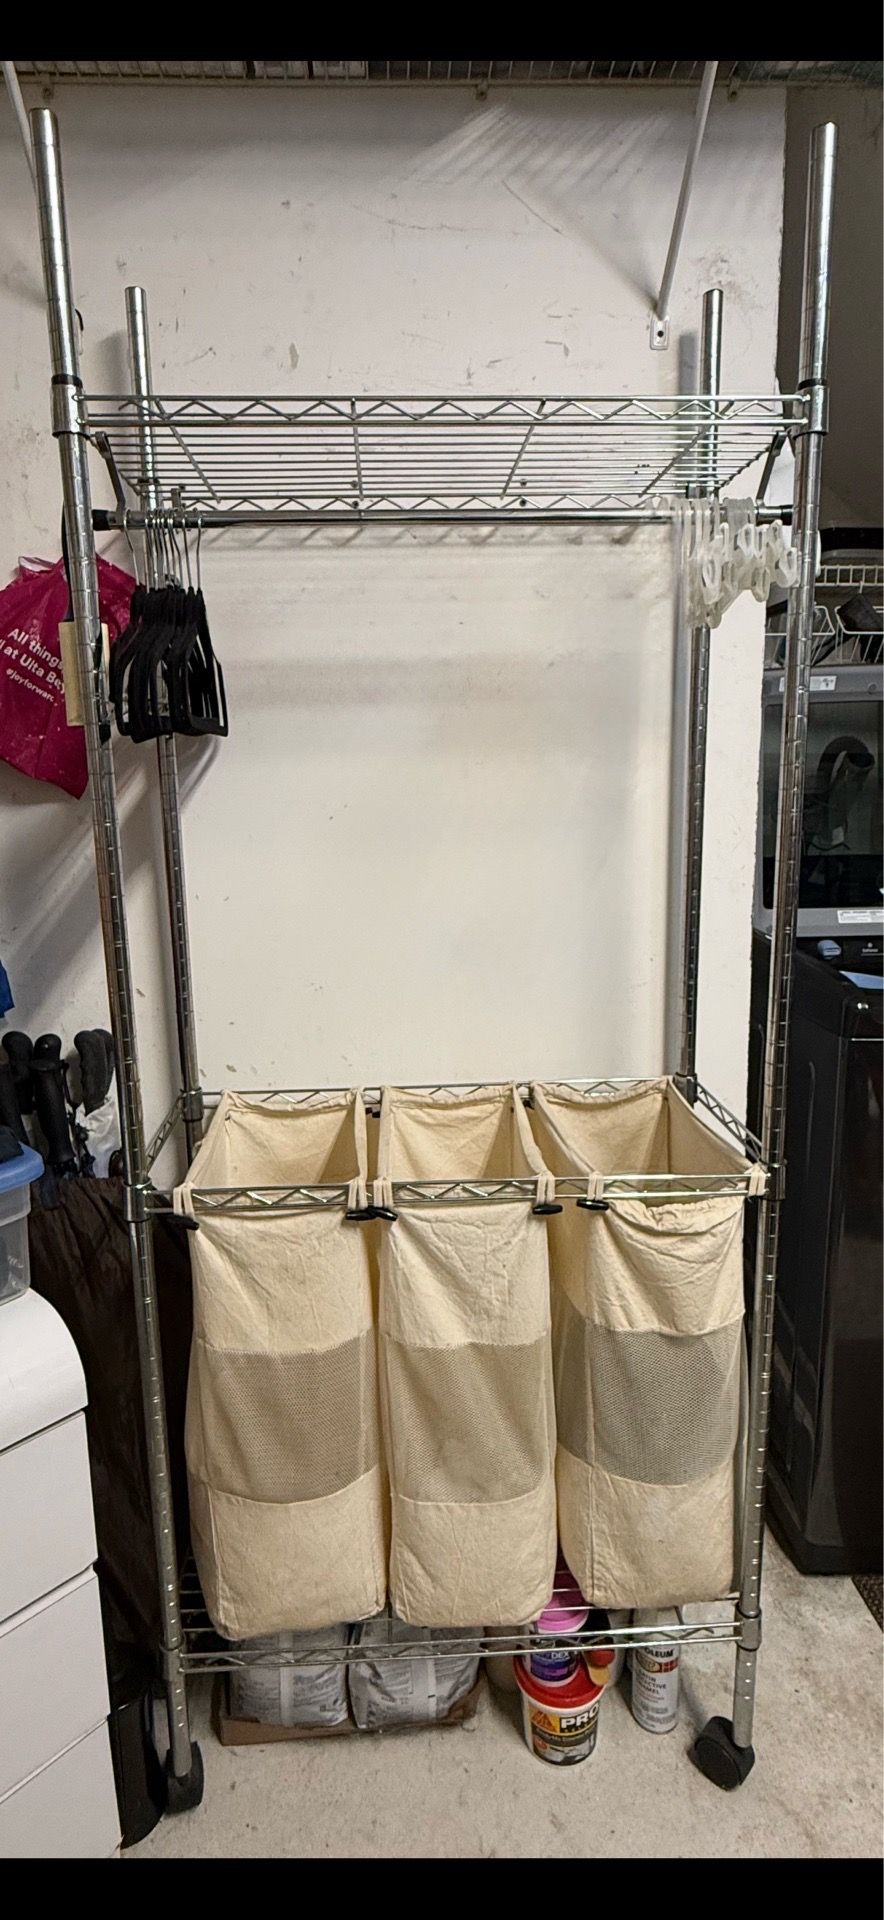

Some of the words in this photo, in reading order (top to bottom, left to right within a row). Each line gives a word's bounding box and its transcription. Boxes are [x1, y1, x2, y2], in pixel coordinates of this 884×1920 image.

[7, 628, 29, 645] All
[3, 646, 19, 660] at
[20, 653, 45, 678] Ulta
